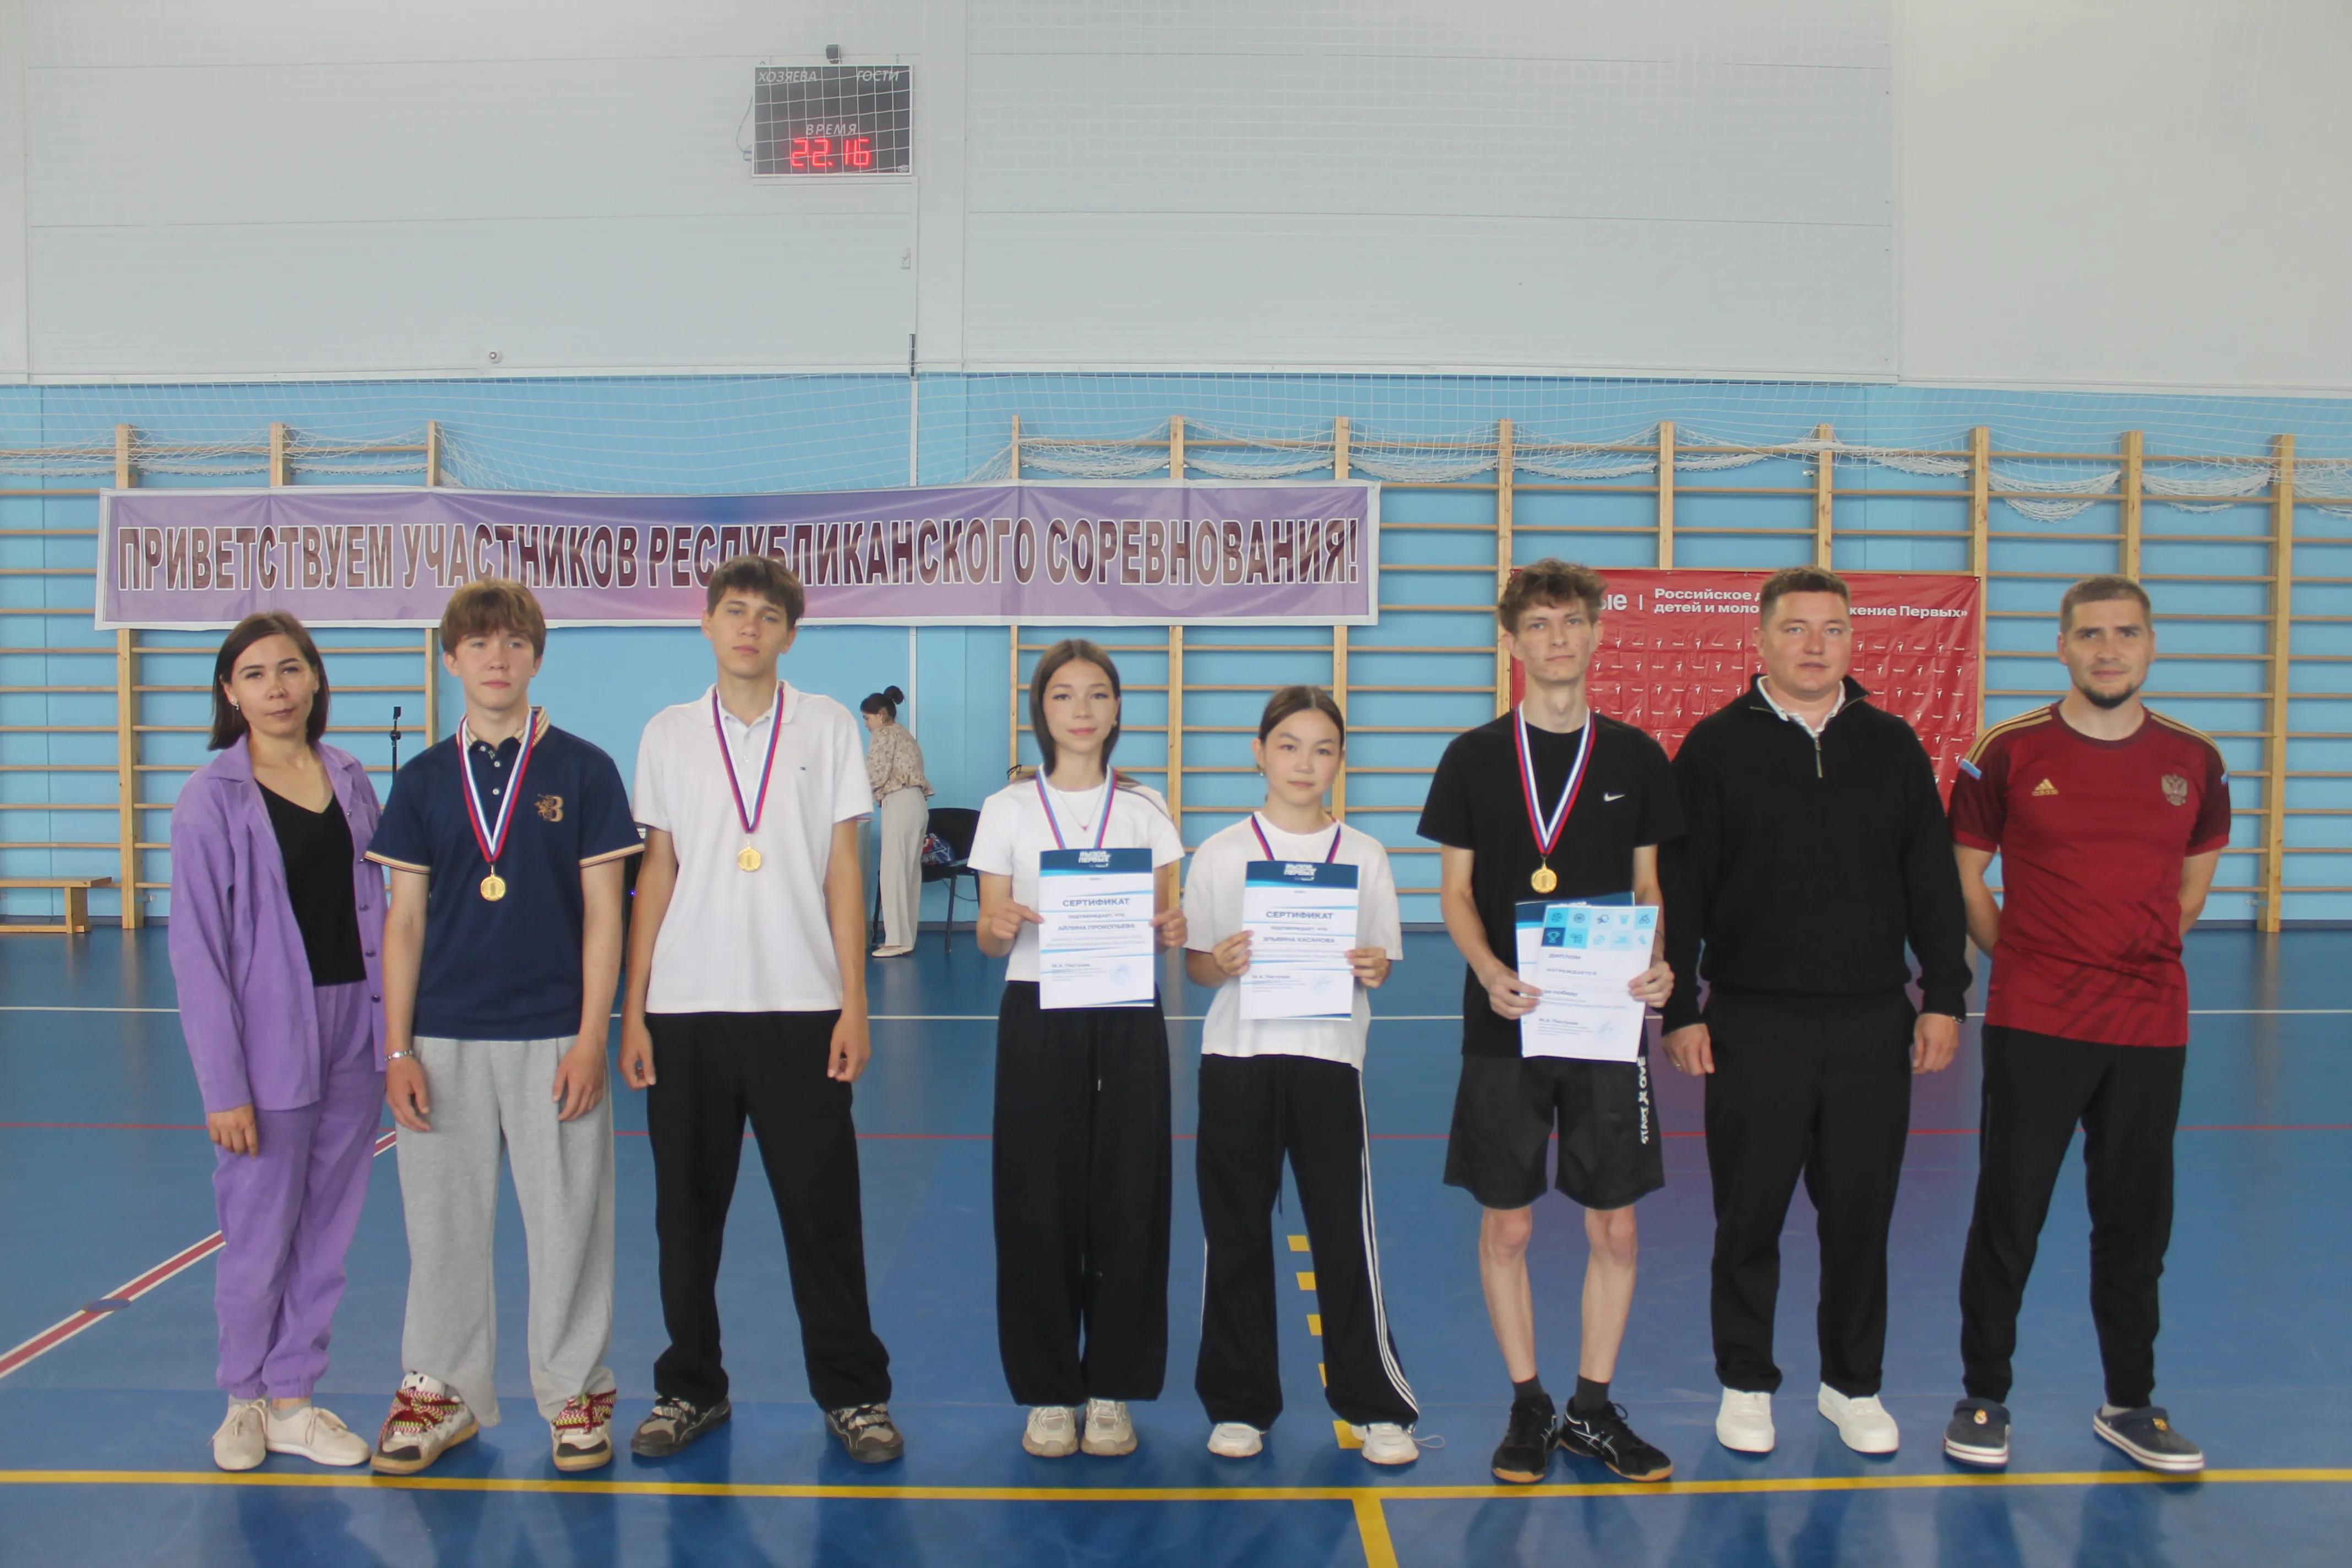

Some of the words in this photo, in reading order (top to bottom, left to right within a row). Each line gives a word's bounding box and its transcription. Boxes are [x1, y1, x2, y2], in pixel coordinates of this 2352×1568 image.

[758, 71, 817, 82] ХОЗЯЕВА
[856, 70, 899, 81] ГОСТИ
[805, 123, 857, 135] ВРЕМЯ
[791, 138, 871, 167] 22.16
[117, 525, 394, 591] ПРИВЕТСТВУЕМ
[401, 522, 639, 590] УЧАСТНИКОВ
[1046, 518, 1359, 586] СОРЕВНОВАНИЯ!
[1654, 588, 1752, 601] Российское
[1654, 602, 1701, 614] детей
[1705, 605, 1714, 613] и
[1718, 605, 1760, 613] моло
[1899, 606, 1968, 619] Первых»
[1063, 898, 1130, 907] СЕРТИФИКАТ
[1266, 911, 1333, 919] СЕРТИФИКАТ
